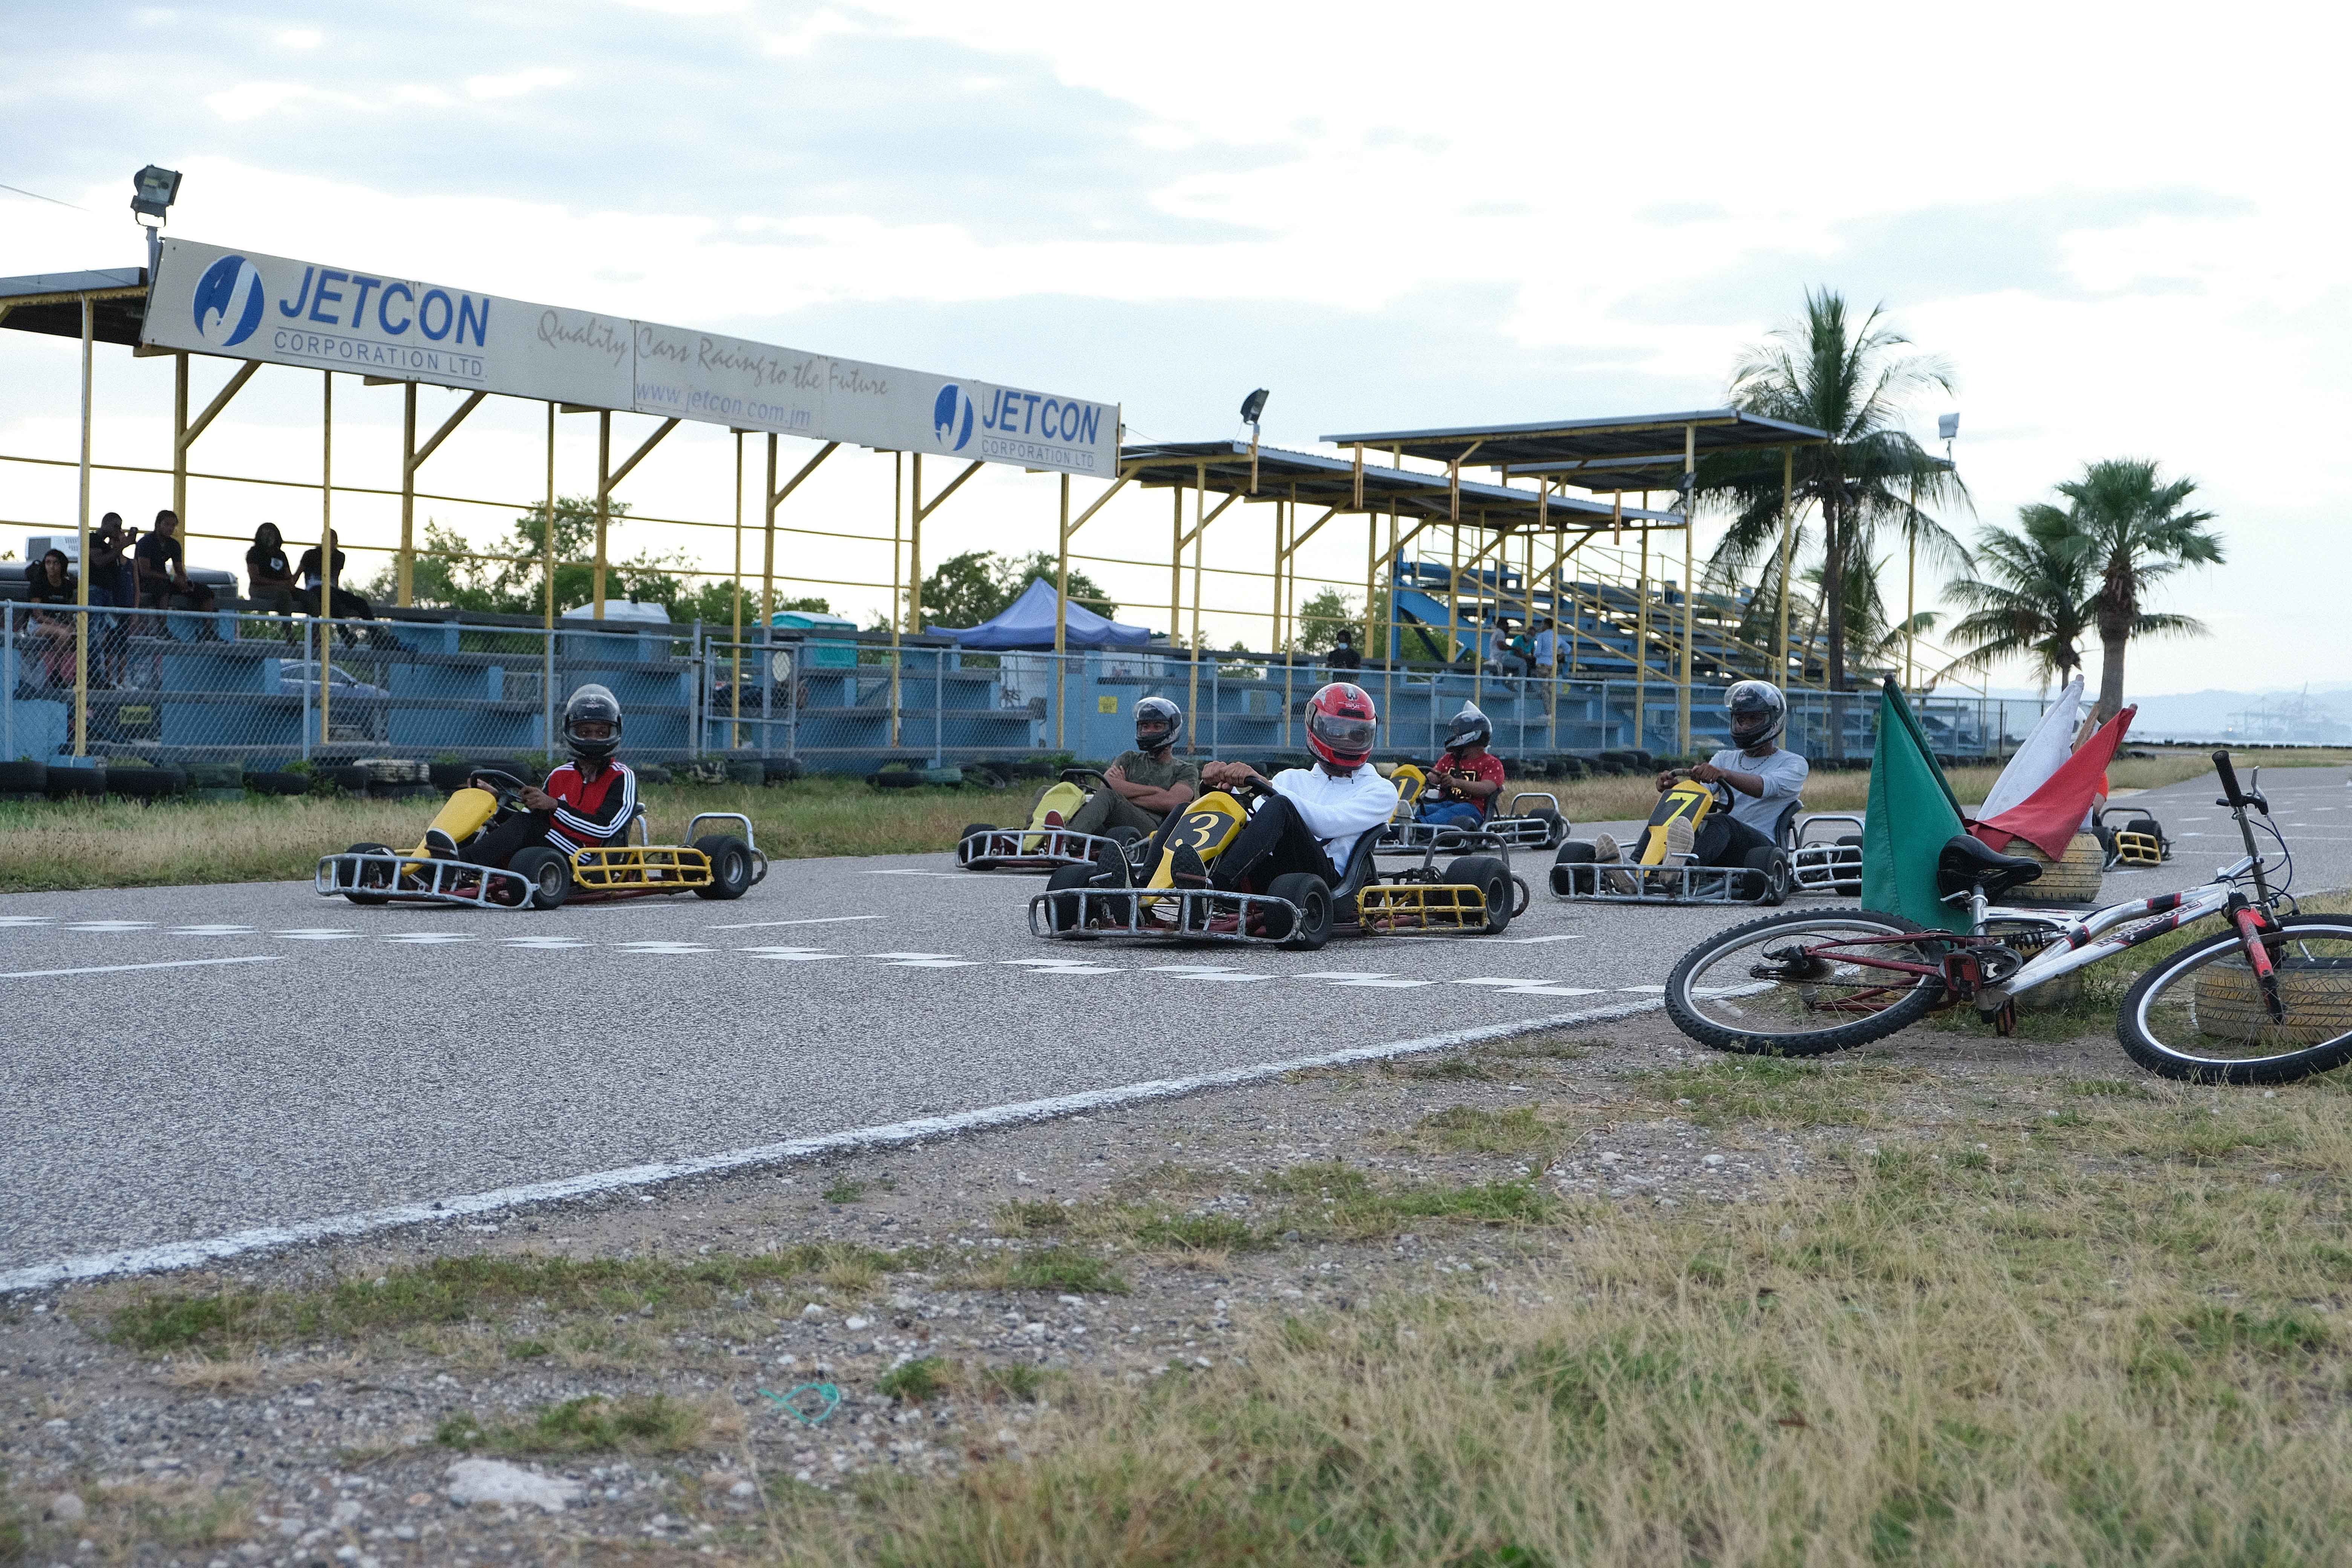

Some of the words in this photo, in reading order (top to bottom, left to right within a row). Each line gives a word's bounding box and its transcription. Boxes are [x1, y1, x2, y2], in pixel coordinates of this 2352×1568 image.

[279, 266, 489, 347] JETCON
[274, 331, 438, 370] CORPORATION
[537, 309, 628, 368] Quality
[635, 326, 691, 362] Cars
[697, 337, 765, 387] Racing
[767, 359, 787, 384] to
[792, 359, 822, 389] the
[829, 361, 888, 395] Future
[635, 383, 811, 429] www.jetconcom.jm
[983, 389, 1101, 444] JETCON
[982, 439, 1070, 464] CORPORATION
[1075, 453, 1093, 467] LTD
[1398, 778, 1409, 800] 1
[1665, 792, 1699, 827] 7
[1175, 814, 1219, 848] 3
[2093, 901, 2202, 946] MONGOOSE
